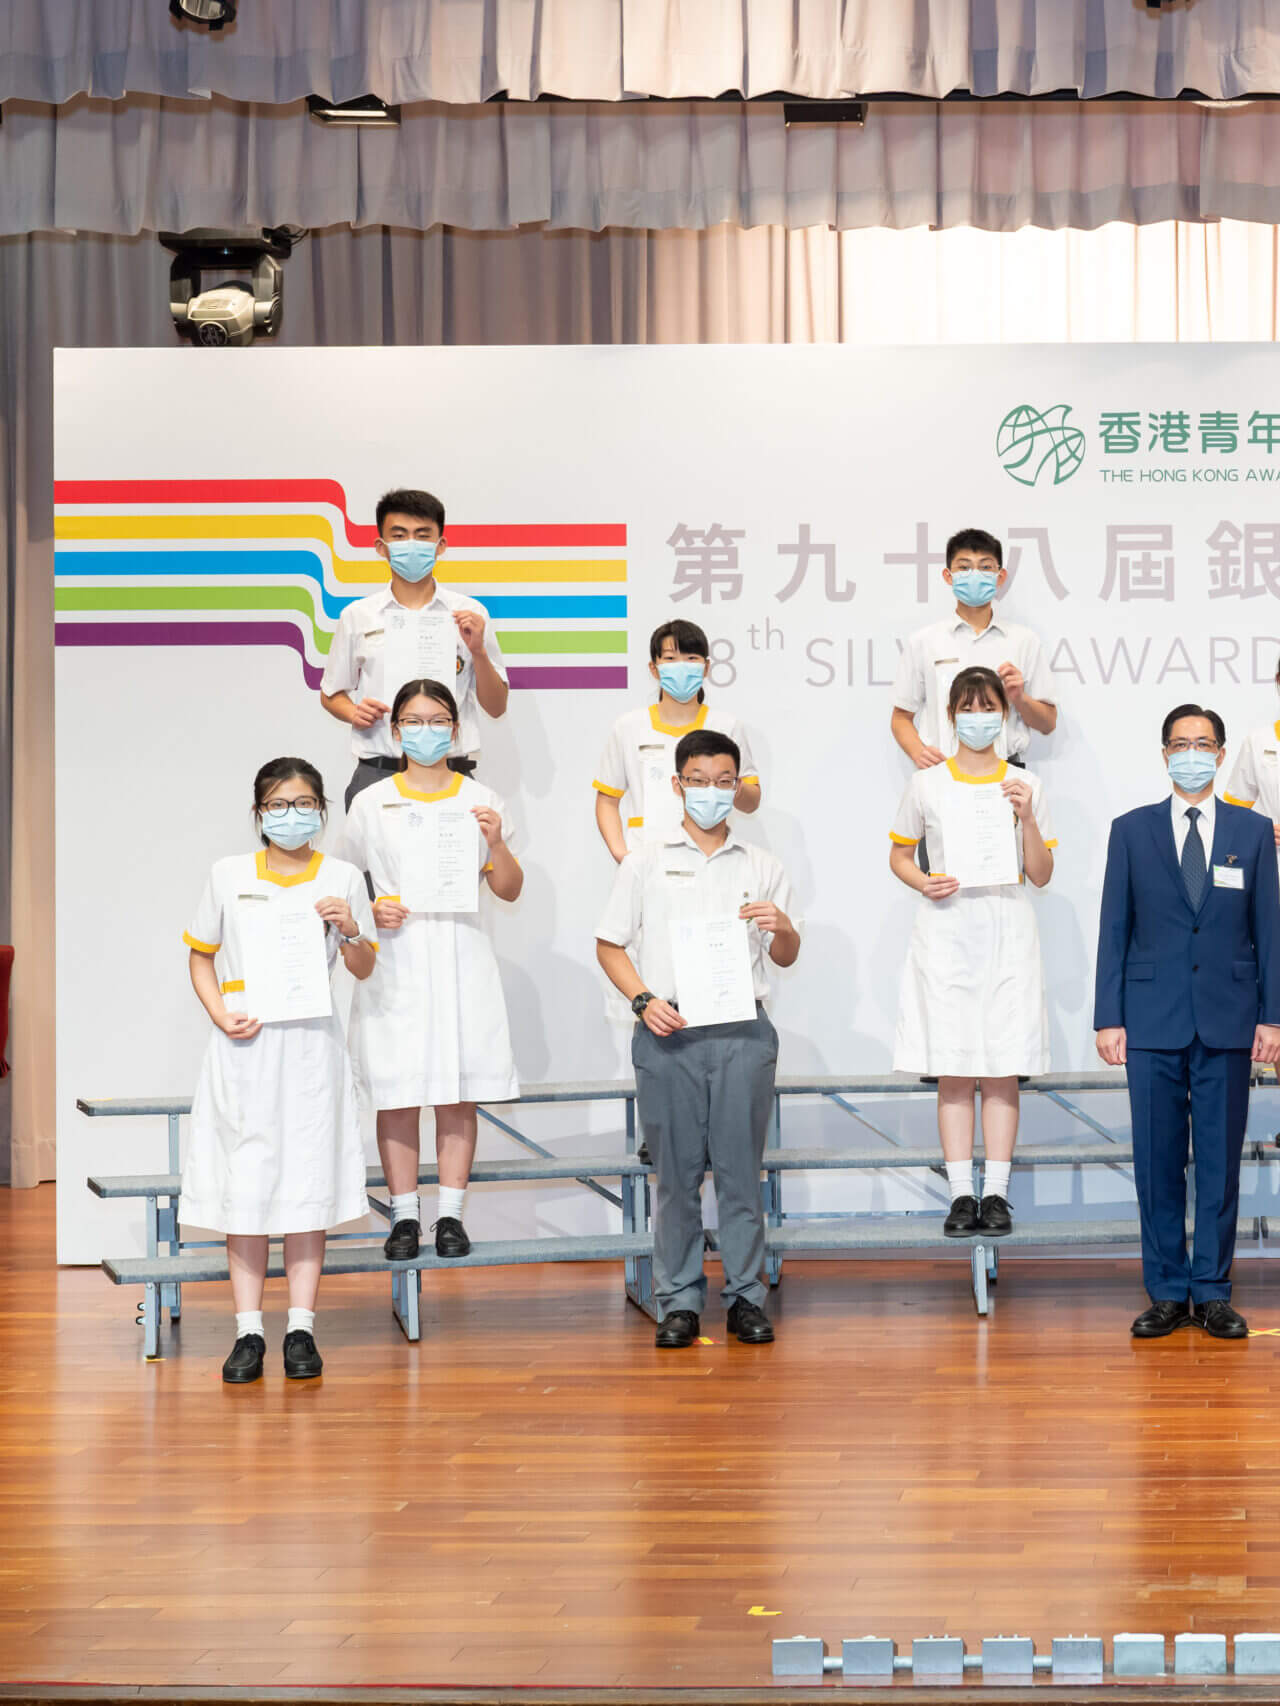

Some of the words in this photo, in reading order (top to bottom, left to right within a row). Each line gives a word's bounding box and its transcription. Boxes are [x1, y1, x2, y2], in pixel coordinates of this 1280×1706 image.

[1098, 468, 1134, 483] THE
[1139, 468, 1187, 483] HONG
[1192, 468, 1239, 483] KONG
[707, 616, 785, 688] 8th
